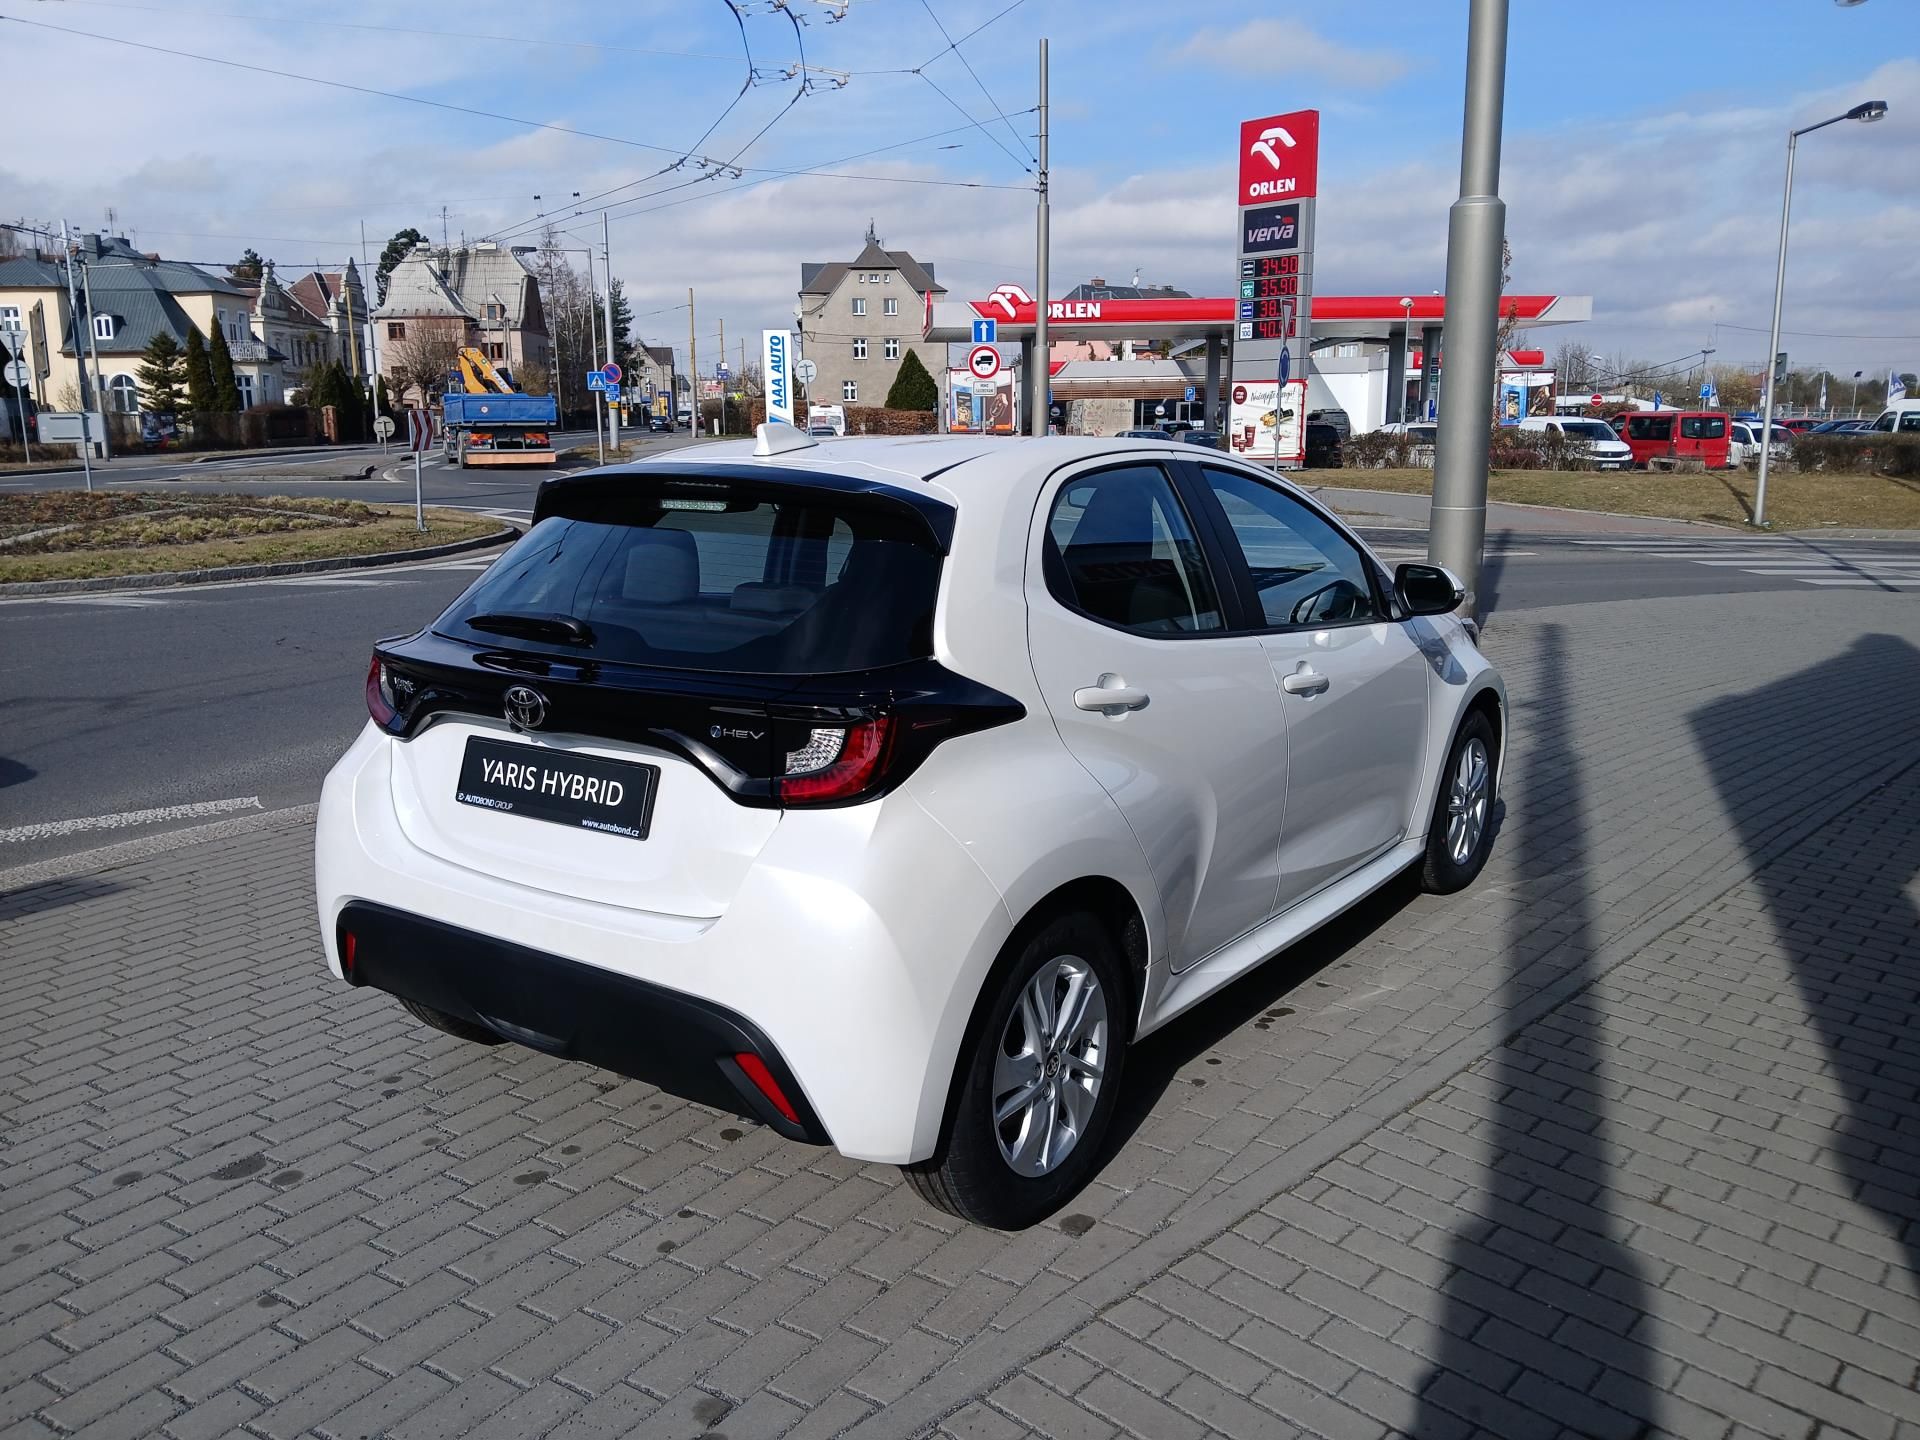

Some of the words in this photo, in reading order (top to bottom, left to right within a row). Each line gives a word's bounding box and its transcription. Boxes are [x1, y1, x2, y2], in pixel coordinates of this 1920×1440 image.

[1249, 177, 1296, 197] ORLEN
[1248, 224, 1295, 243] verva
[1261, 256, 1298, 276] 34.90
[1260, 277, 1297, 297] 35.90
[1258, 320, 1296, 338] 40.0
[769, 335, 783, 374] AUTO
[771, 378, 784, 409] AAA
[723, 728, 765, 740] HEV
[482, 758, 537, 791] YARIS
[540, 769, 624, 807] HYBRID
[464, 793, 495, 807] AUTOBOND
[494, 800, 514, 810] GROUP
[581, 818, 640, 838] www.autobond.cz
